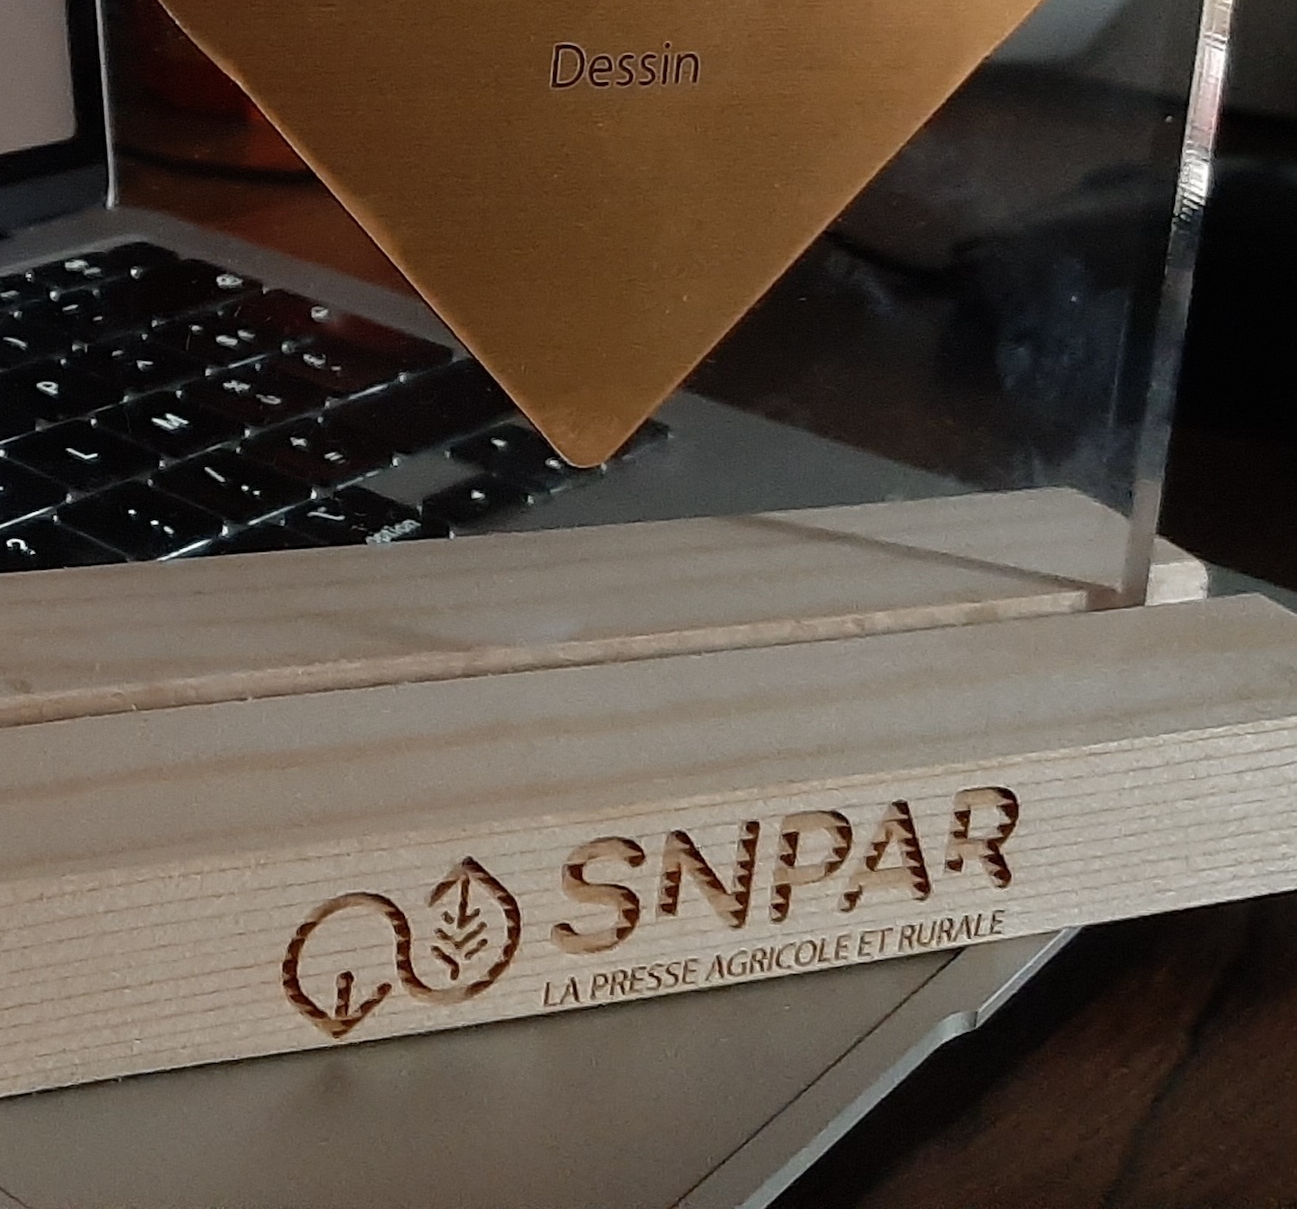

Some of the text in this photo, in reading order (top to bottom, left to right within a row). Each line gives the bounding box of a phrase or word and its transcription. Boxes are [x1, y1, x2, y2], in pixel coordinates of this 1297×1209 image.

[550, 42, 701, 88] Dessin
[550, 786, 1021, 955] SNPAR
[542, 909, 1005, 1008] LA PRESSE AGRICOLE ET RURALE
